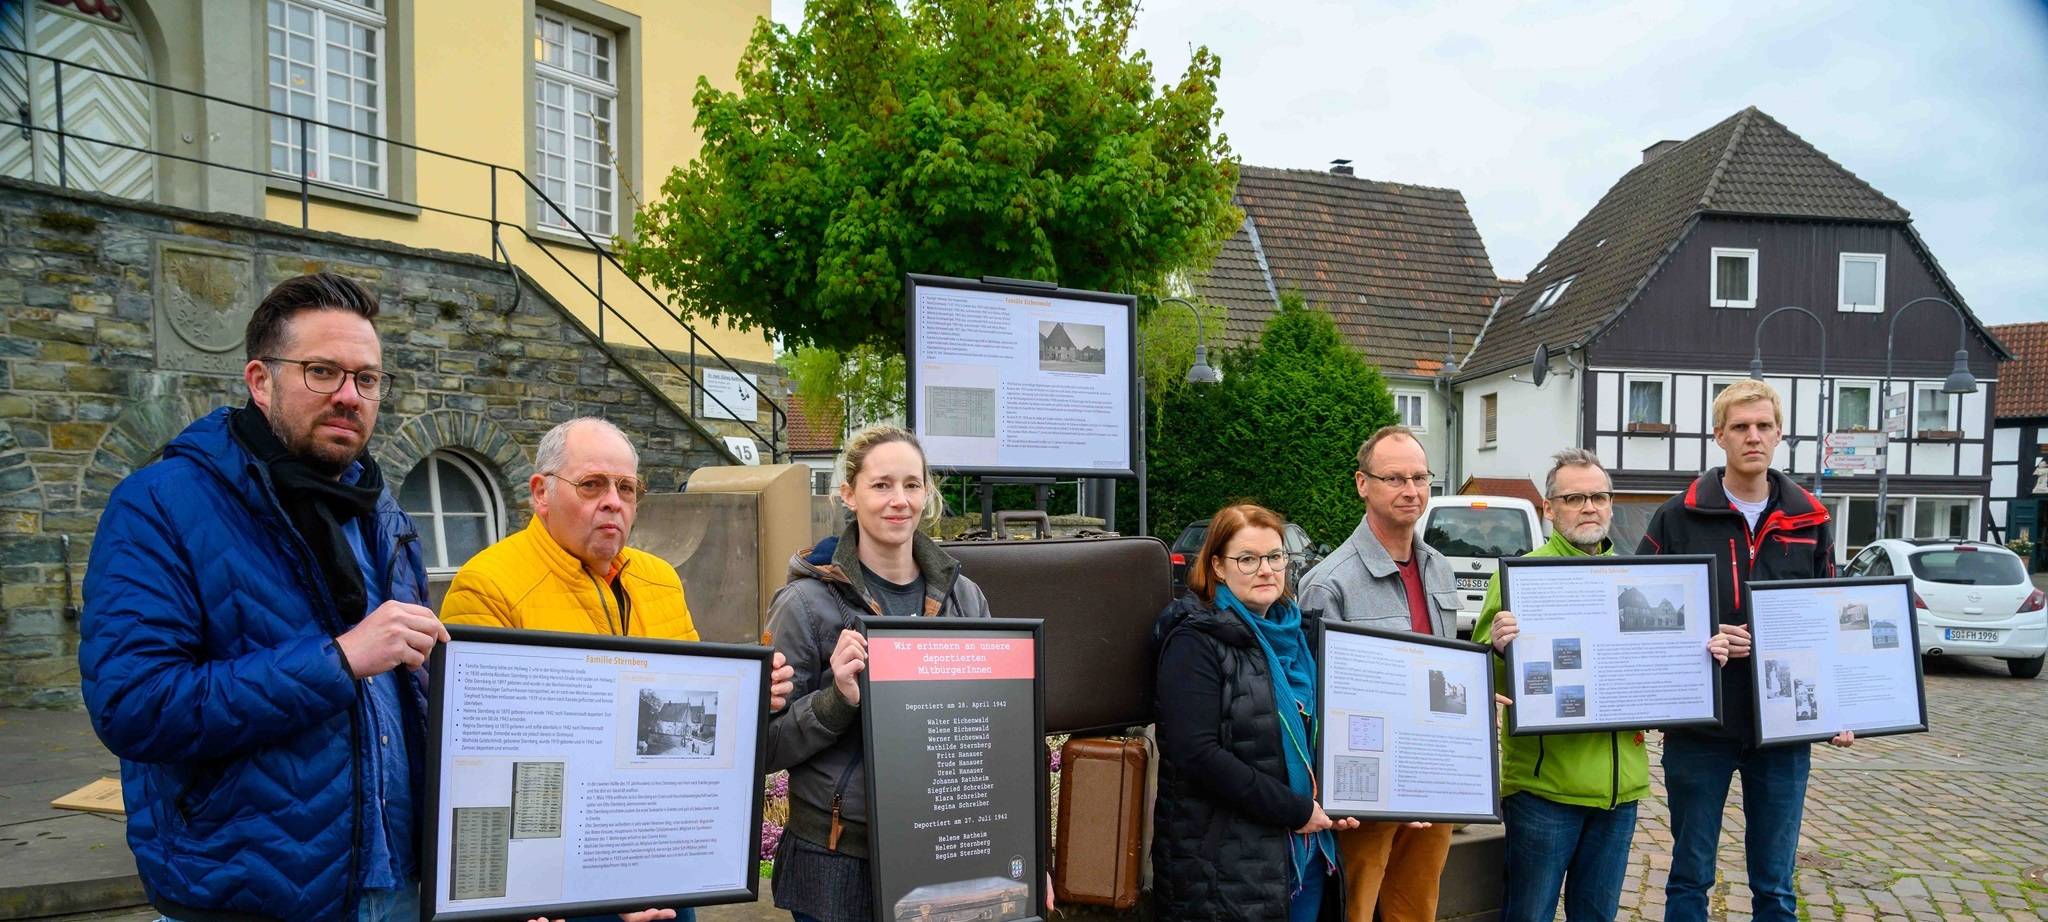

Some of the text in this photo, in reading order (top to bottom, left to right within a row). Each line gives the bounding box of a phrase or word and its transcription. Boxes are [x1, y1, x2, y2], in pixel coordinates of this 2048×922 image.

[203, 354, 247, 372] ERWIT
[735, 445, 752, 461] 15
[1457, 579, 1467, 588] SO
[1951, 630, 1997, 641] SO FH 1996
[894, 641, 1011, 650] Wir erinnern an unsere
[586, 655, 648, 669] Familie Sternberg
[923, 654, 986, 664] deportierten
[906, 703, 944, 711] Deportiert
[972, 701, 990, 709] April
[953, 716, 989, 724] Eichenwald
[960, 742, 992, 750] Sternberg
[936, 760, 956, 768] Trude
[928, 783, 994, 794] Siegfried Schreiber
[935, 792, 988, 802] Klara Schreiber
[933, 800, 990, 812] Regina Schreiber
[914, 820, 951, 830] Deportiert
[938, 832, 988, 842] Helene Ratheim
[935, 840, 991, 852] Helene Sternberg
[935, 848, 991, 860] Regina Sternberg
